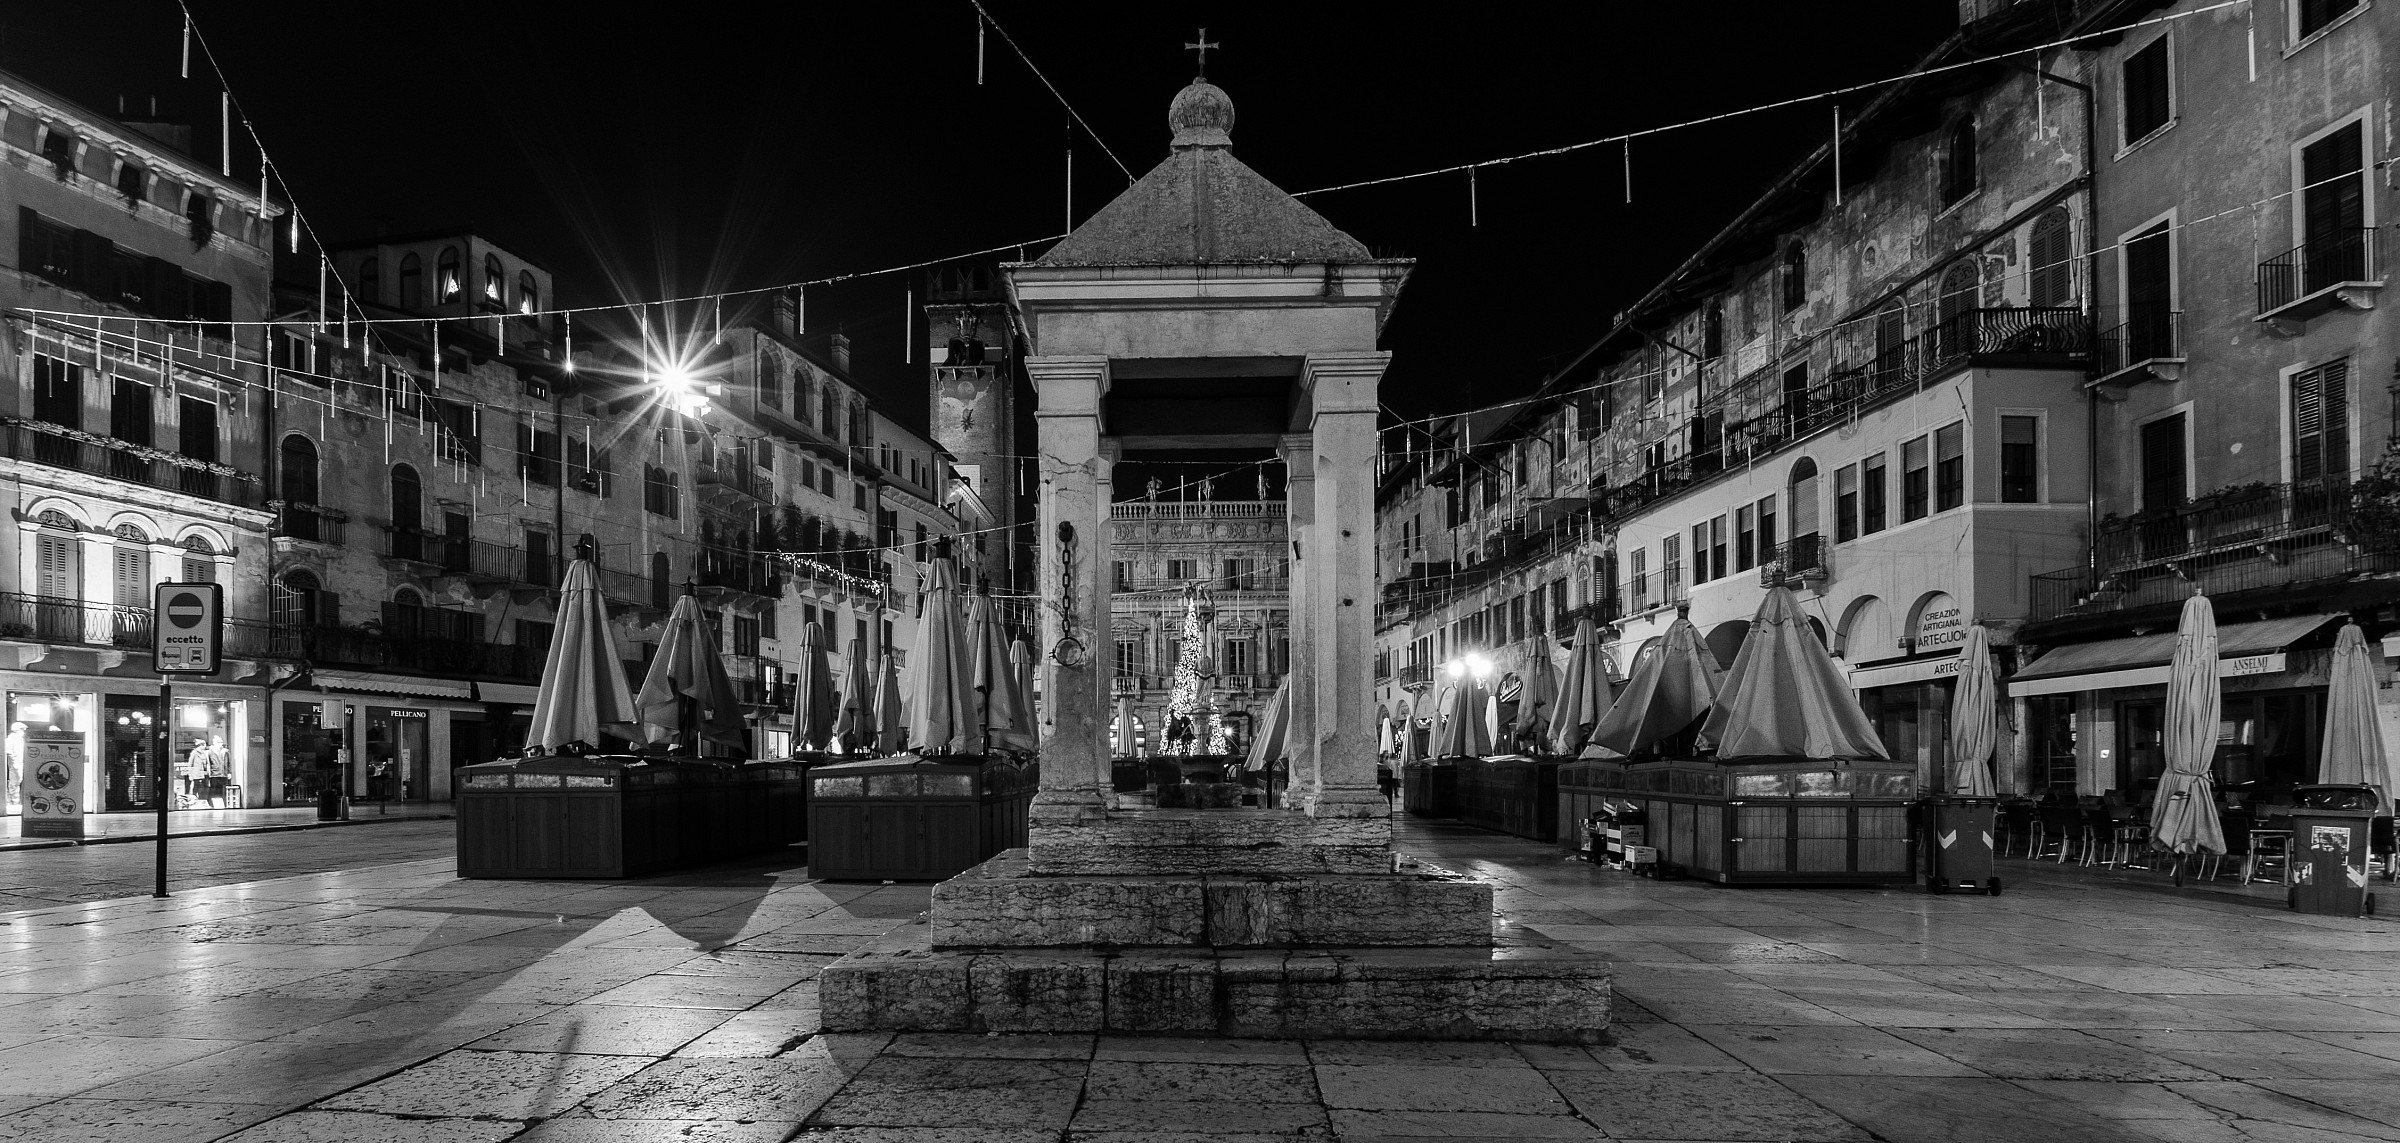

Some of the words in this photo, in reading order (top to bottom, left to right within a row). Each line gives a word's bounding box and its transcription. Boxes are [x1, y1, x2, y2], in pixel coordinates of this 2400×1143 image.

[1925, 608, 1960, 621] CREAZION
[1923, 619, 1962, 632] ARTIGIANAL
[166, 635, 204, 644] eccetto
[1918, 630, 1967, 647] ARTECUOI
[1934, 662, 1959, 675] ARTEC
[2232, 656, 2268, 671] ANSELMI
[2380, 681, 2393, 690] 22
[390, 710, 427, 719] PELLICANO
